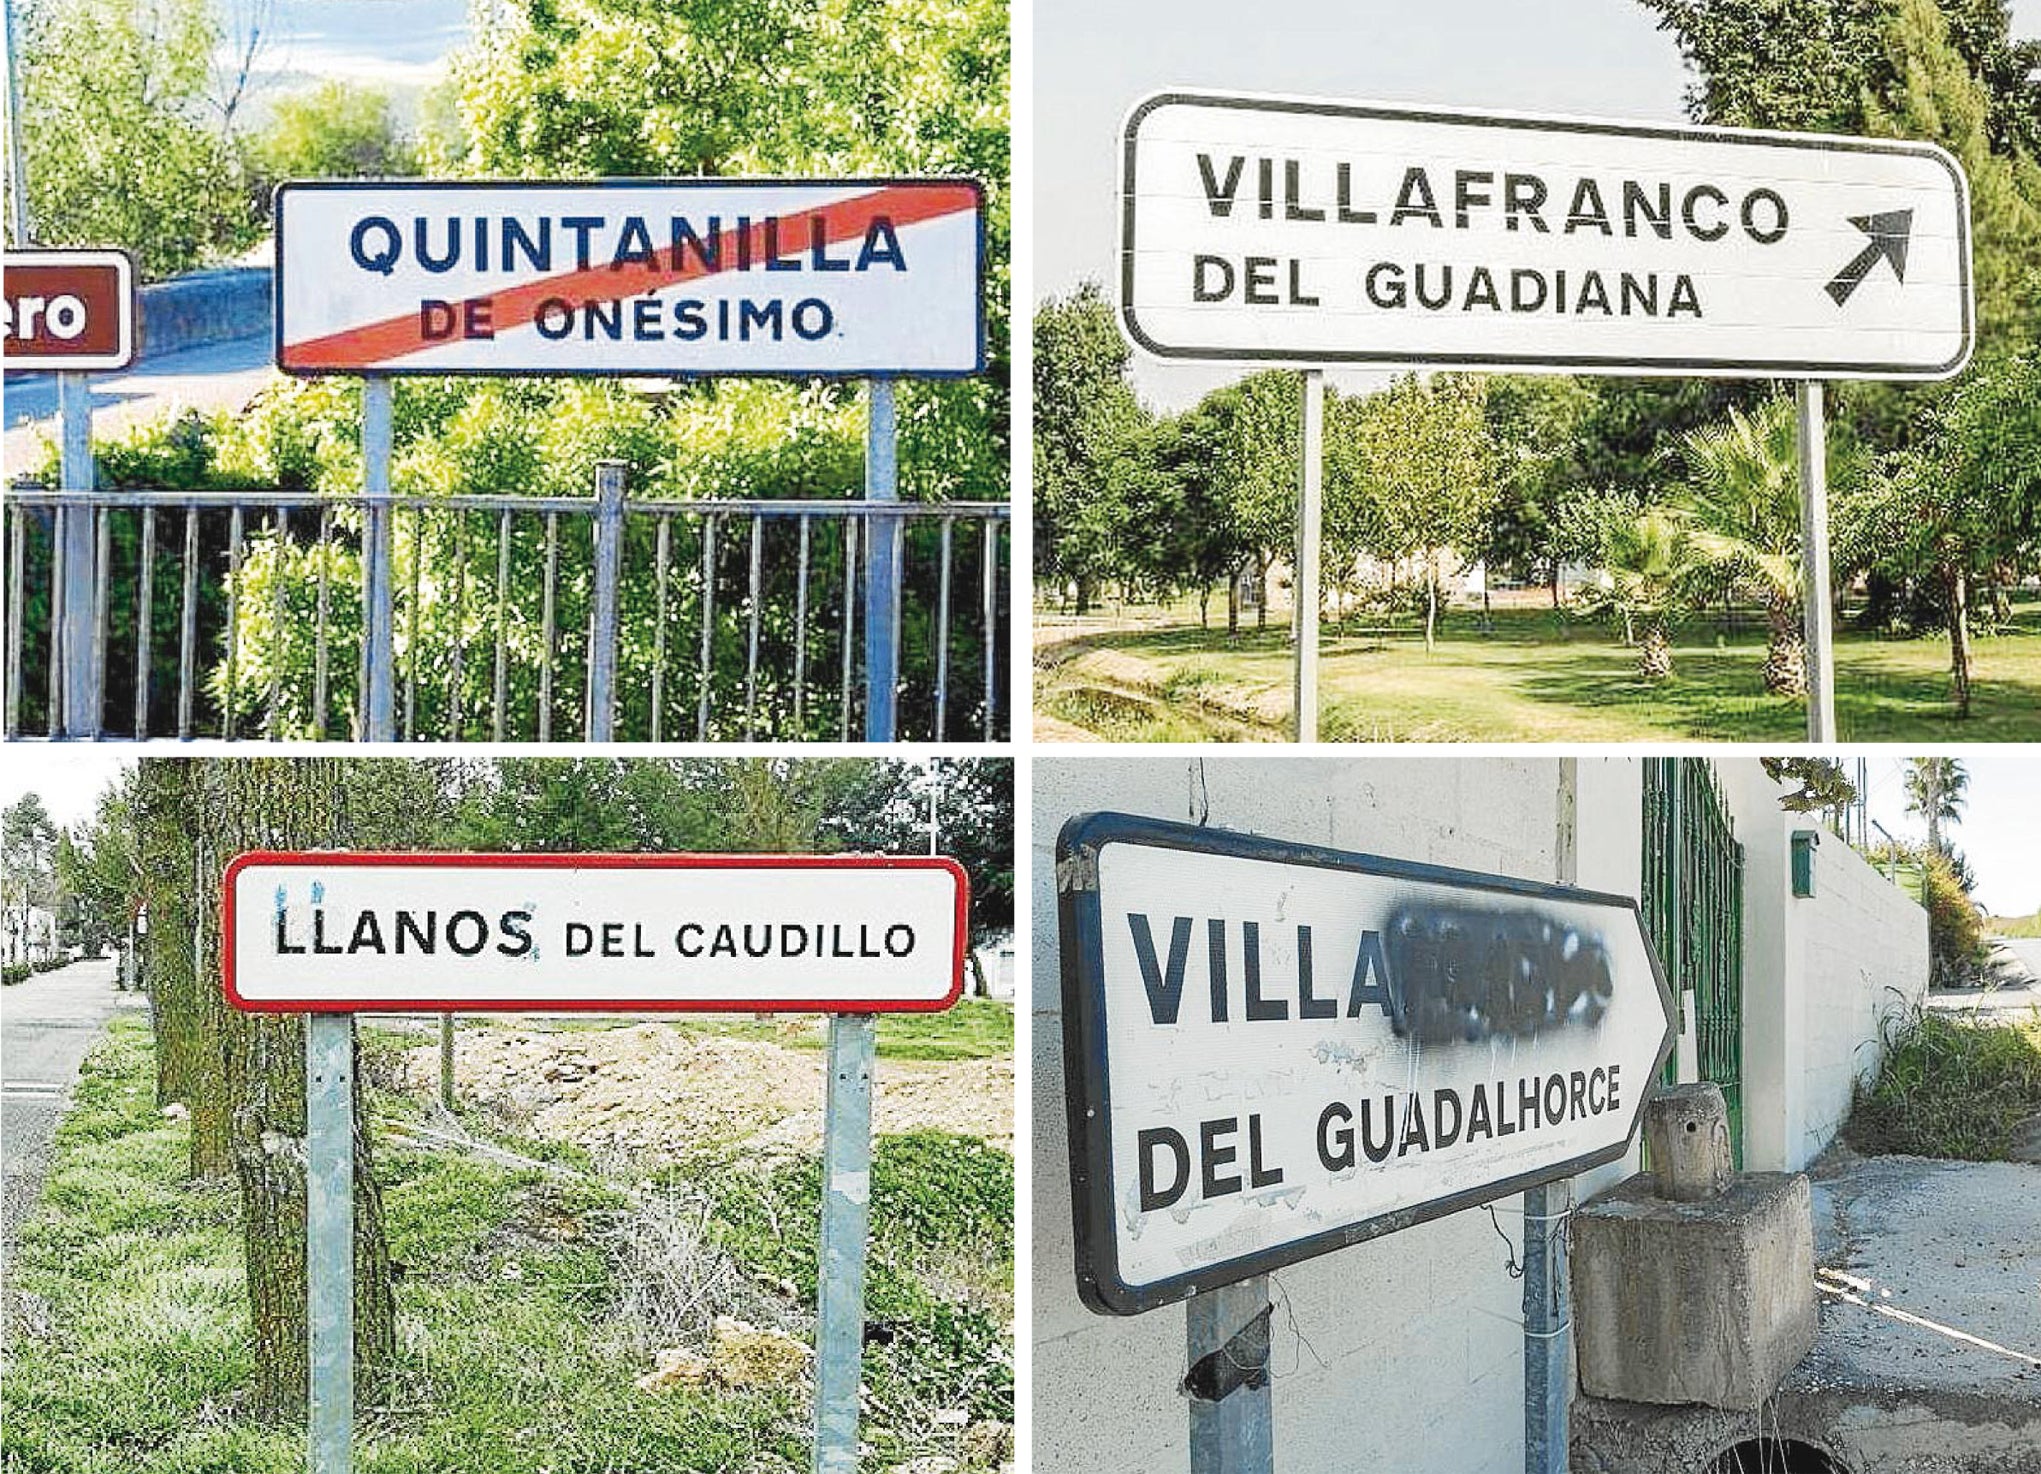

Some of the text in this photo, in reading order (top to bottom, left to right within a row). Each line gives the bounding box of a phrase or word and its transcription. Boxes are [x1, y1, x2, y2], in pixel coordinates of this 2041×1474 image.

[1197, 153, 1789, 245] VILLAFRANCO
[350, 215, 907, 275] QUINTANILLA
[4, 294, 87, 340] ro
[420, 290, 834, 341] DE ONÉSIMO
[1193, 255, 1703, 319] DEL GUADIANA
[276, 908, 916, 959] LLANOS DEL CAUDILLO
[1137, 1064, 1621, 1213] DEL GUADALHORCE
